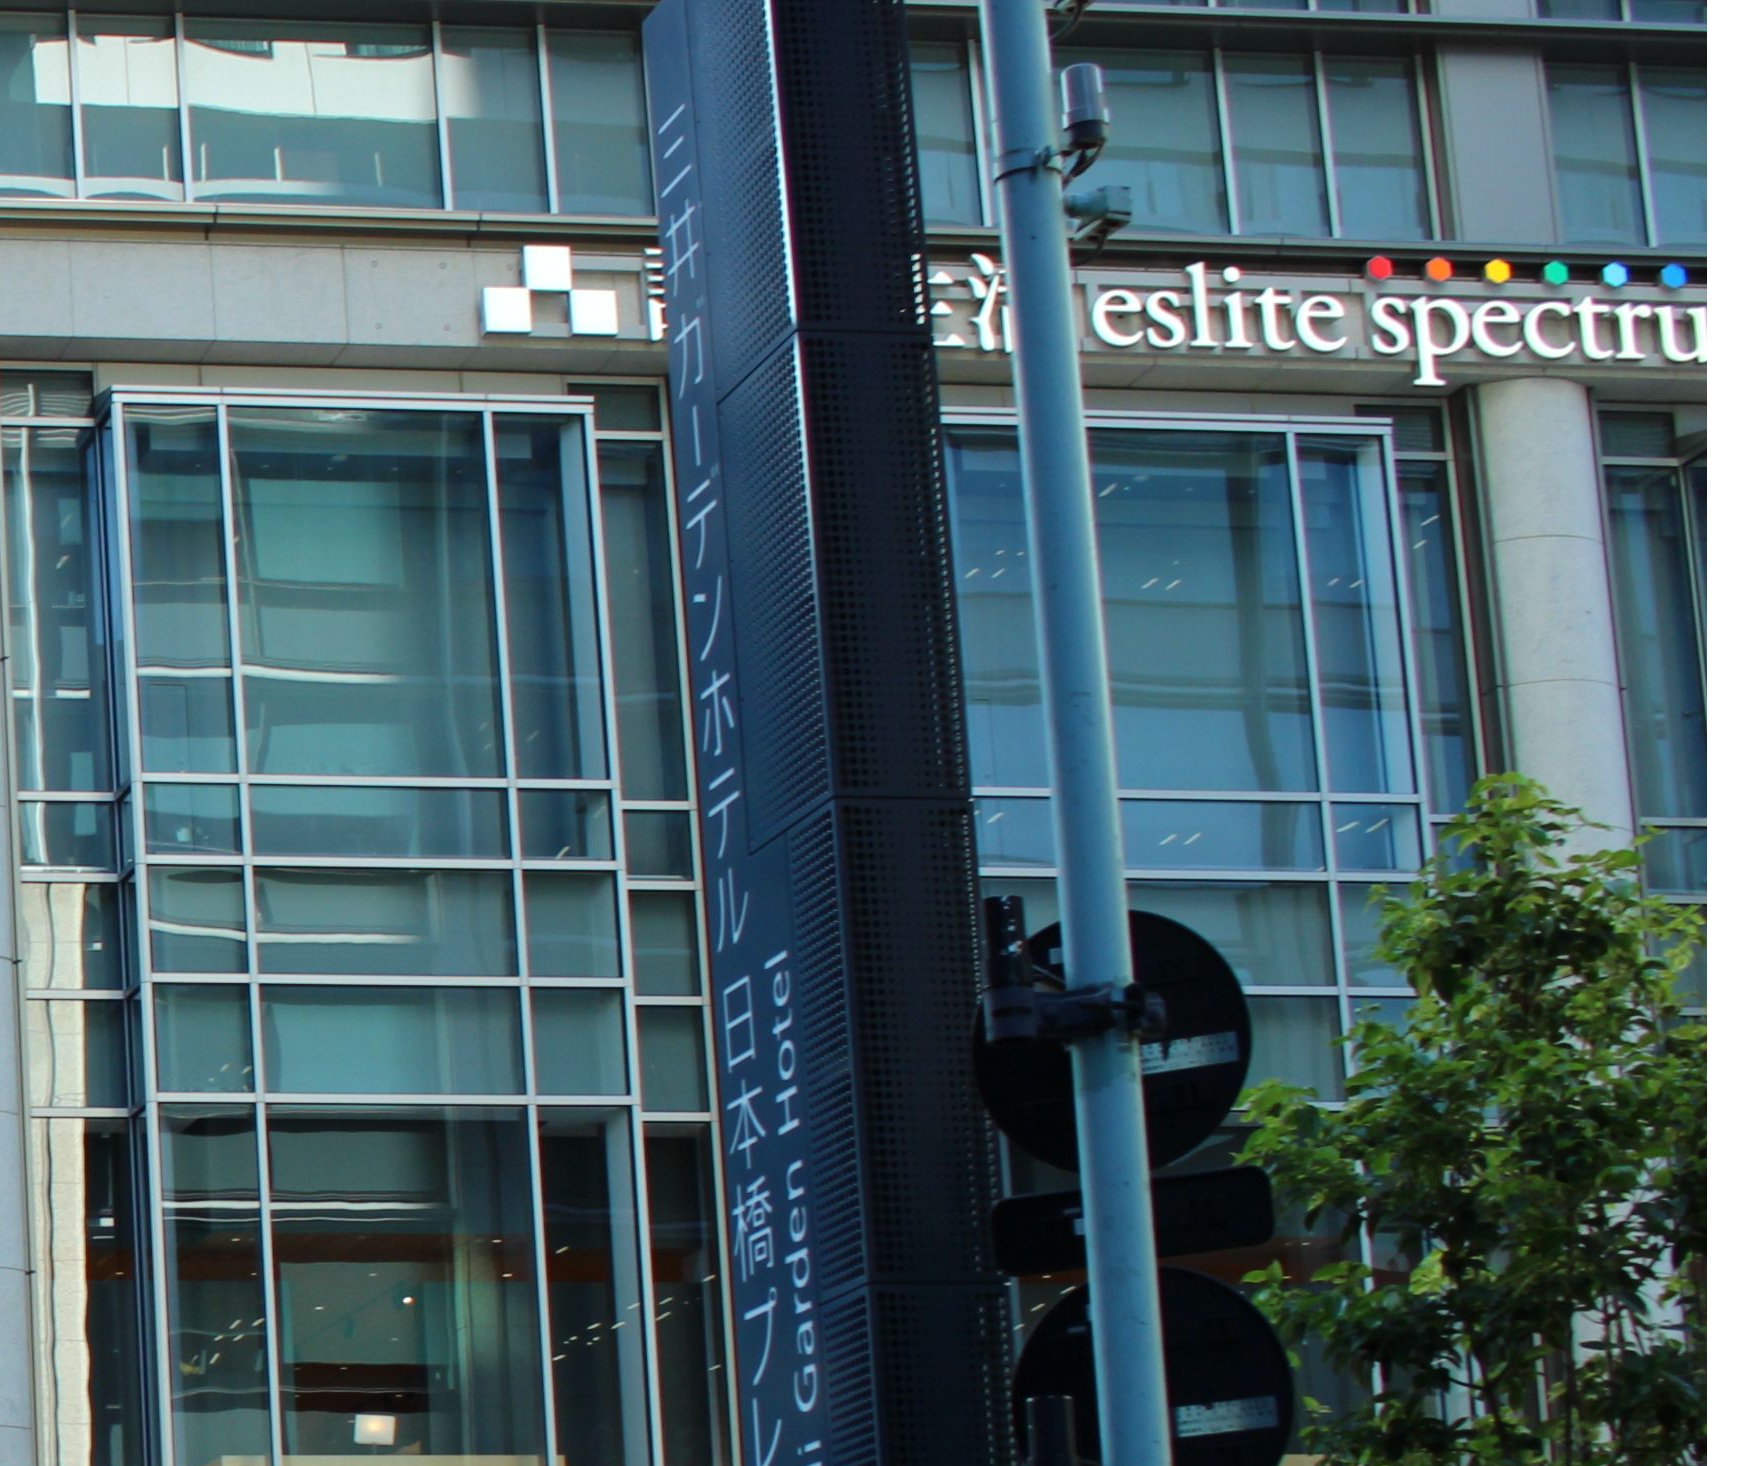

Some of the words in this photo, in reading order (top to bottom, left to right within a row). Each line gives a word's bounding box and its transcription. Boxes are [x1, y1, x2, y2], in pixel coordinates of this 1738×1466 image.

[1091, 261, 1348, 354] eslite
[657, 103, 750, 954] 三井ガーデンホテル
[769, 950, 800, 1135] Hotel
[783, 1159, 818, 1411] Garden
